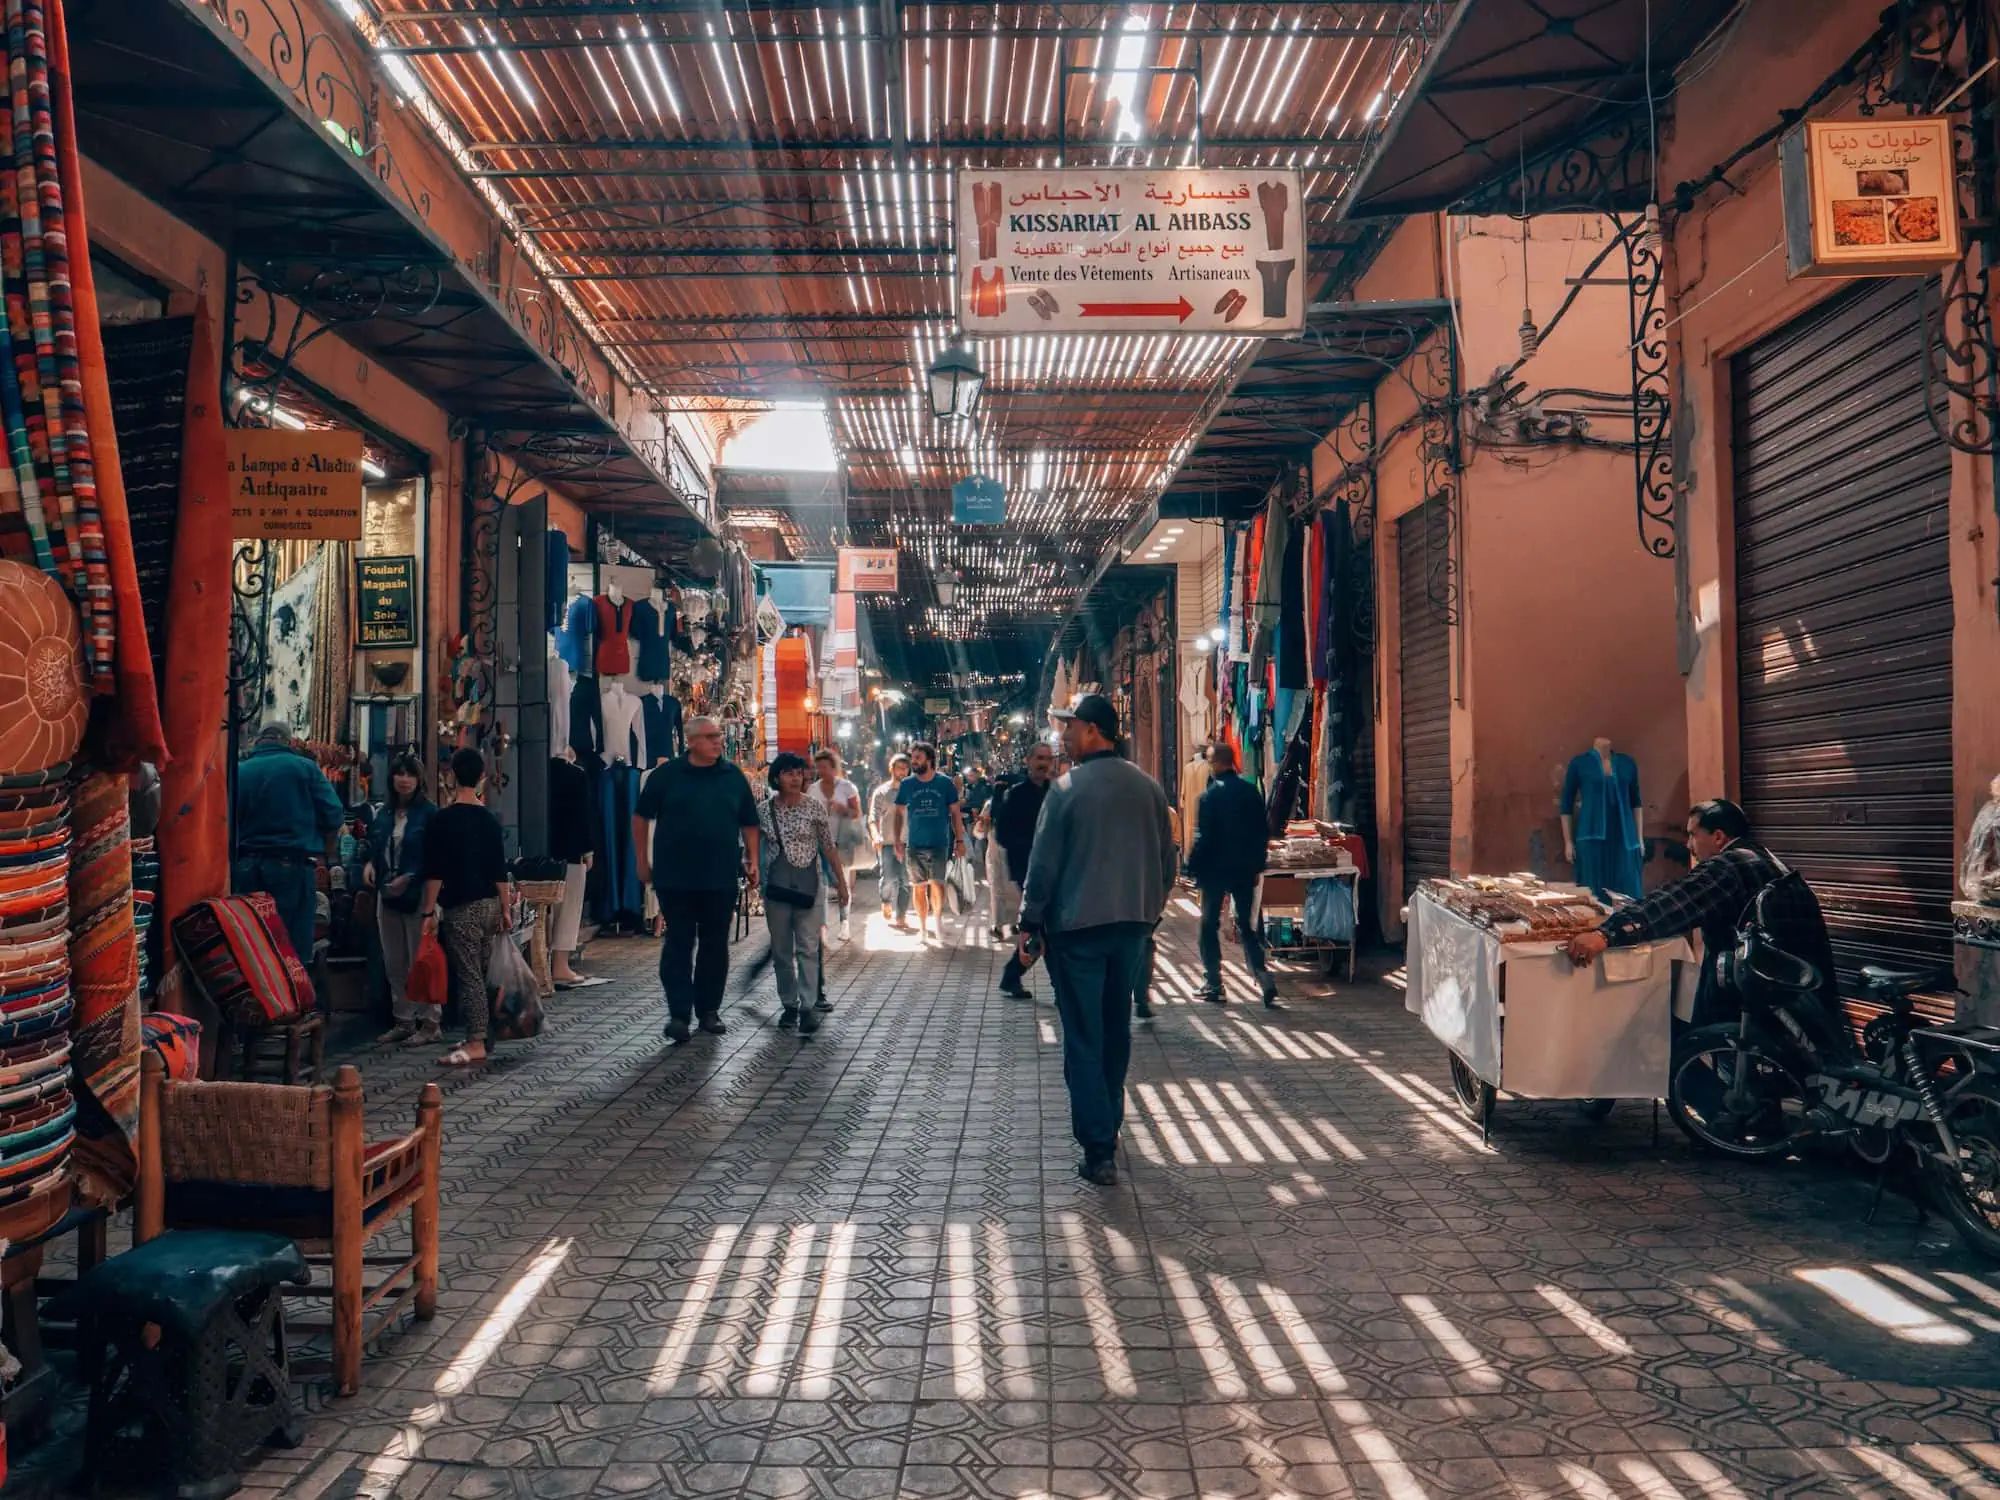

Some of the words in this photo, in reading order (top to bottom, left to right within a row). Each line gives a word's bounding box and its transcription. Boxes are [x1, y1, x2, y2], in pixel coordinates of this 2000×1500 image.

[1827, 133, 1859, 156] دنيا
[1867, 129, 1933, 153] حلويات
[1841, 154, 1877, 169] مغربية
[1881, 151, 1920, 166] حلويات
[1008, 180, 1120, 207] الأحباس
[1145, 183, 1251, 207] قيسارية
[1010, 213, 1122, 233] KISSARIAT
[1135, 212, 1160, 232] AL
[1168, 212, 1251, 231] AHBASS
[1013, 241, 1073, 260] التقليدية
[1080, 240, 1131, 258] الملابس
[1137, 236, 1171, 262] أنواع
[1177, 243, 1215, 260] جميع
[1221, 243, 1244, 260] بيع
[1010, 265, 1050, 281] Vente
[1054, 265, 1077, 281] des
[1080, 264, 1153, 281] Vêtements
[1168, 264, 1251, 281] Artisaneaux
[241, 453, 287, 477] Lampe
[240, 476, 328, 501] Antiquaire
[364, 565, 405, 575] Foulard
[362, 579, 408, 591] Magasin
[378, 596, 393, 605] du
